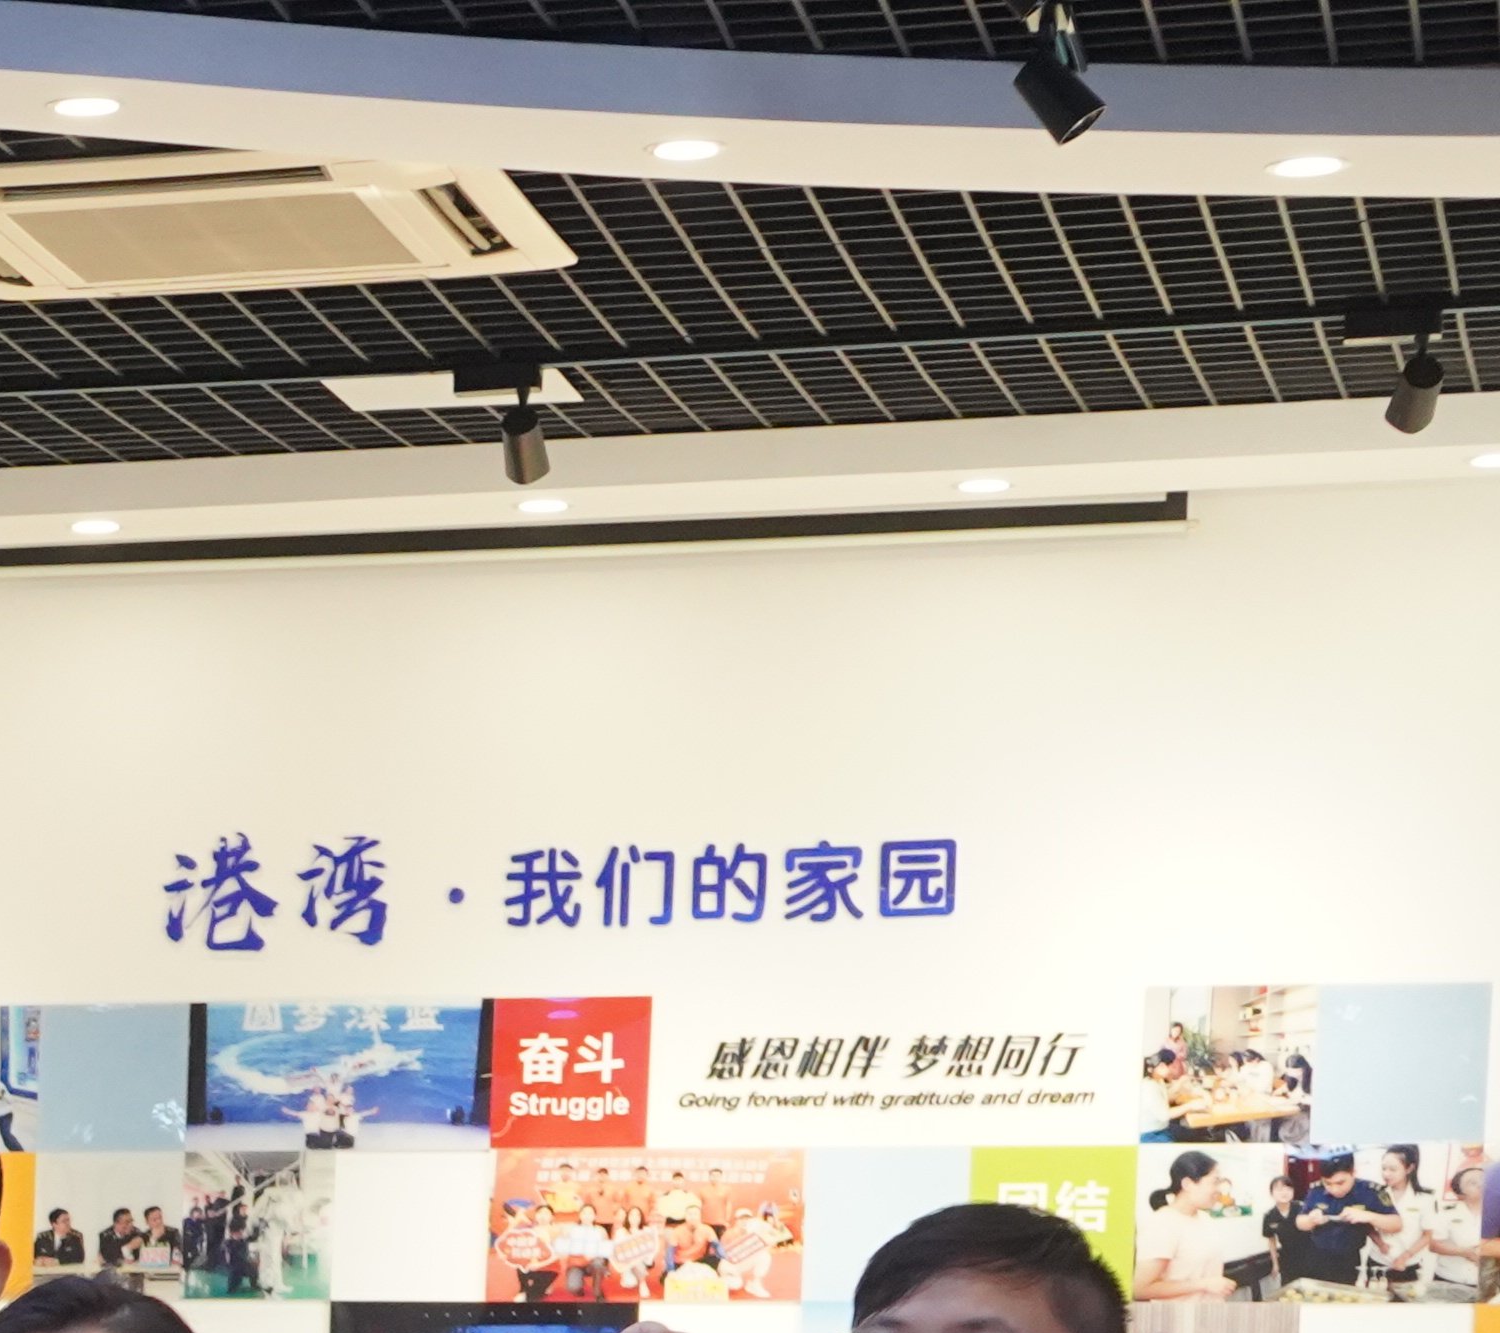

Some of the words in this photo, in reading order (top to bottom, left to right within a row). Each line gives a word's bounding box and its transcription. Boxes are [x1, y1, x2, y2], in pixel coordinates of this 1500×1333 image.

[519, 1032, 626, 1085] 奋斗
[706, 1035, 891, 1081] 感恩相伴
[902, 1033, 1089, 1080] 梦想同行
[509, 1091, 631, 1121] Struggle
[678, 1092, 741, 1111] Going
[746, 1090, 827, 1108] forward
[832, 1089, 876, 1107] with
[880, 1089, 976, 1110] gratitude
[980, 1089, 1021, 1105] and
[1026, 1088, 1095, 1105] dream
